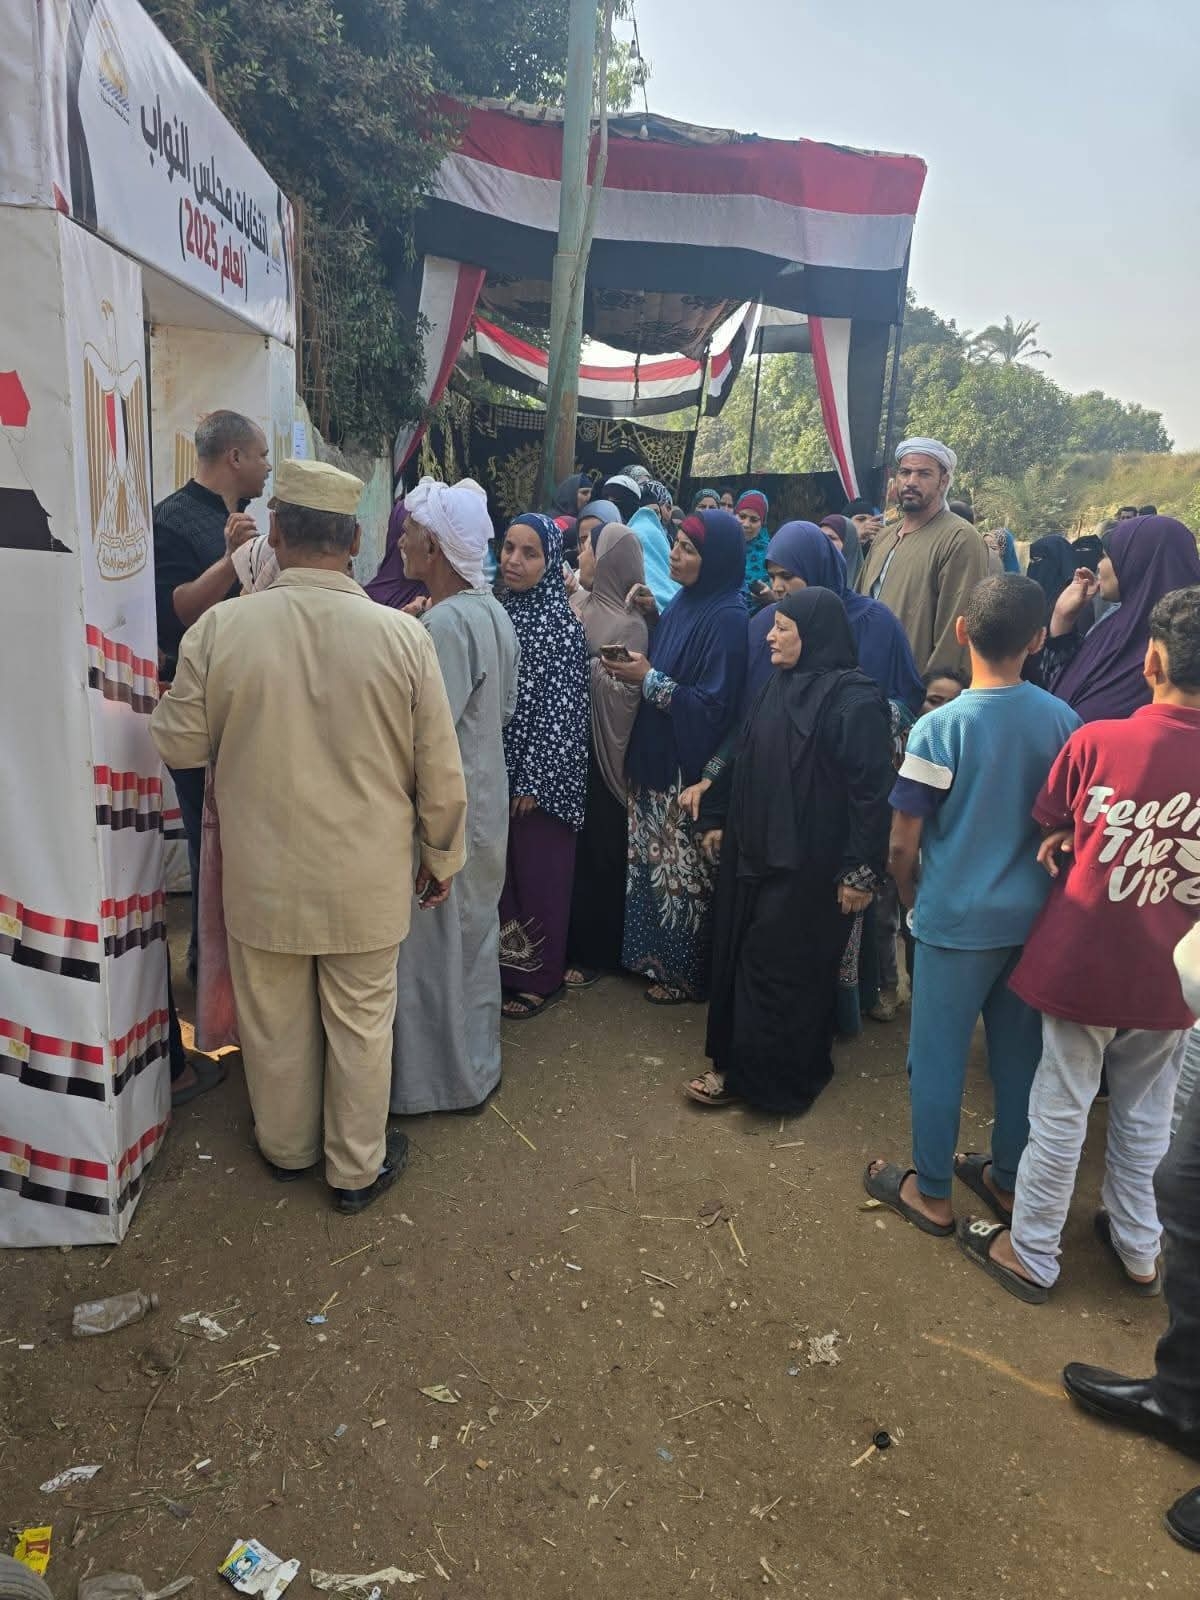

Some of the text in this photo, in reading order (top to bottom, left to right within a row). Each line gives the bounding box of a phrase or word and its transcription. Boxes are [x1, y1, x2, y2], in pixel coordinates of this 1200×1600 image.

[140, 93, 192, 184] النواب
[193, 155, 234, 228] مجلس
[1083, 785, 1200, 837] Feeli
[1098, 826, 1174, 868] The
